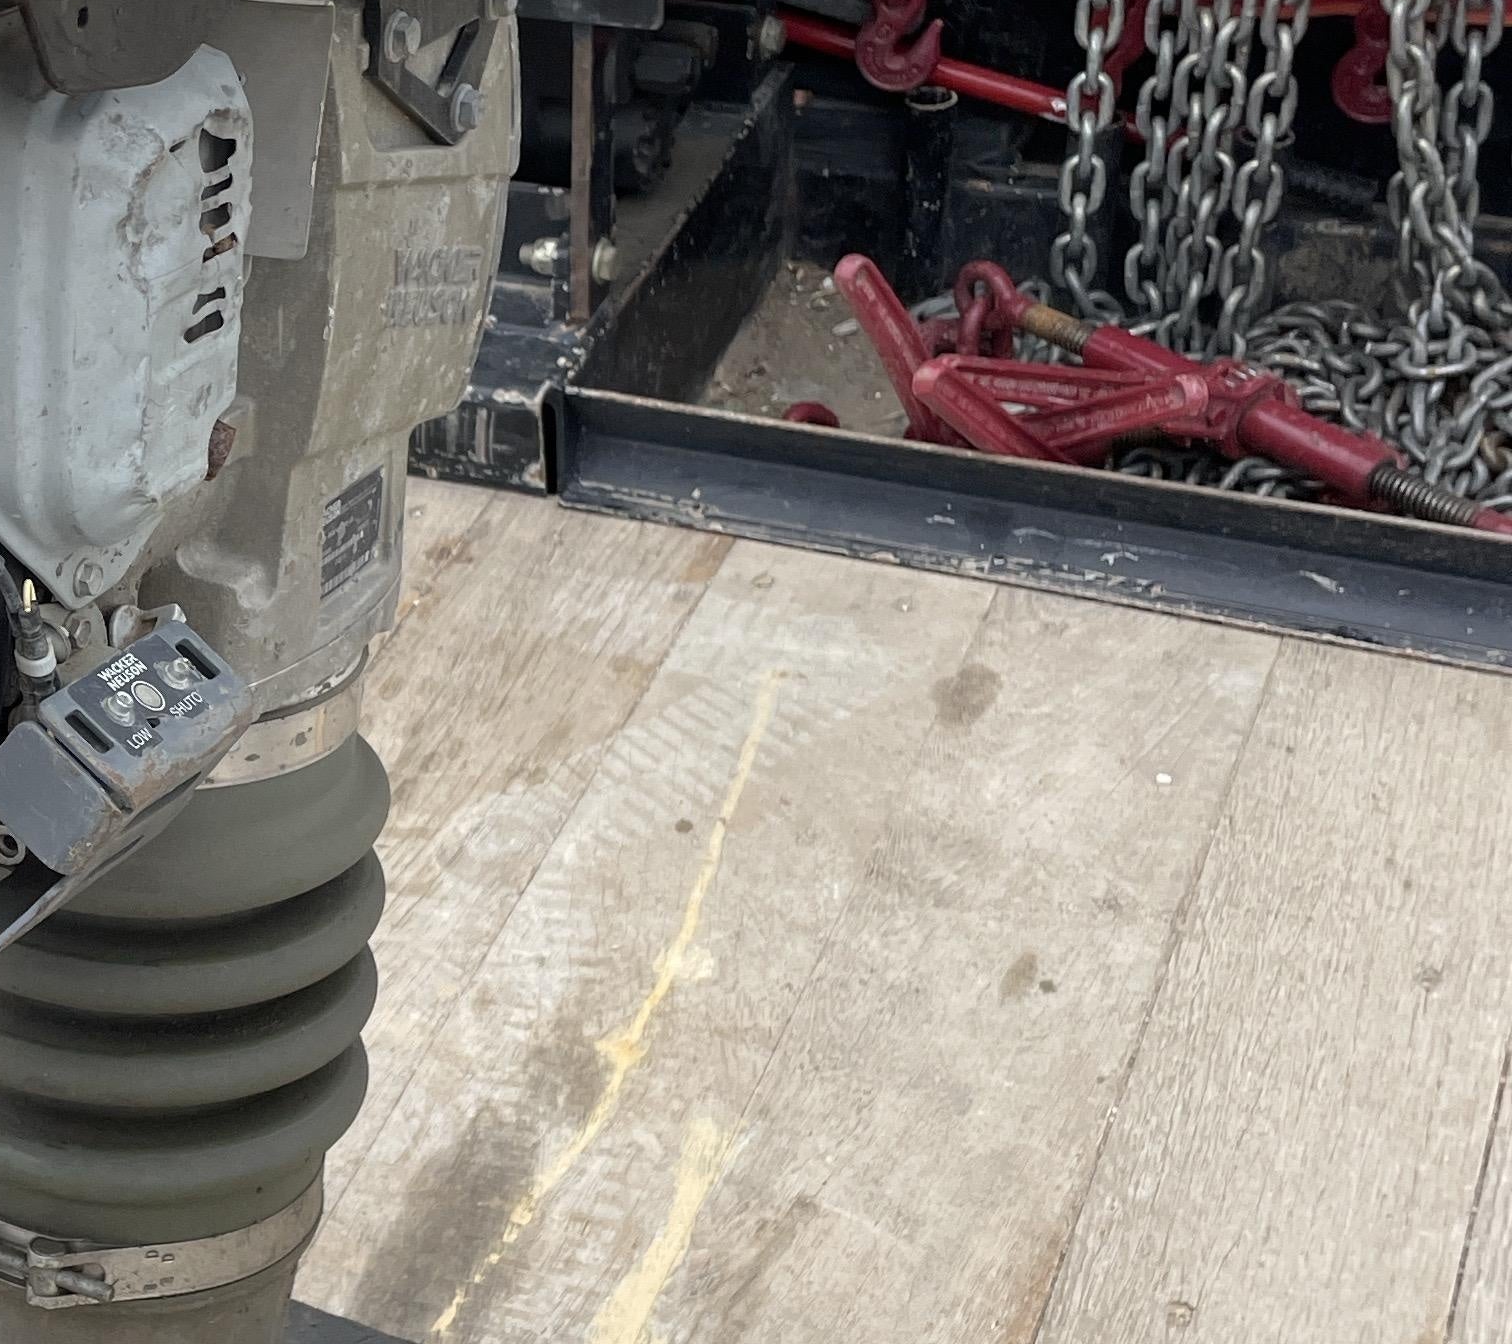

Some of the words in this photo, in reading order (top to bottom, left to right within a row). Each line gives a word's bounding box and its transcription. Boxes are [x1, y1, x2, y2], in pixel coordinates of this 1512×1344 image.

[96, 652, 139, 682] WACKER
[106, 661, 148, 692] NEUSON
[126, 727, 153, 750] LOW
